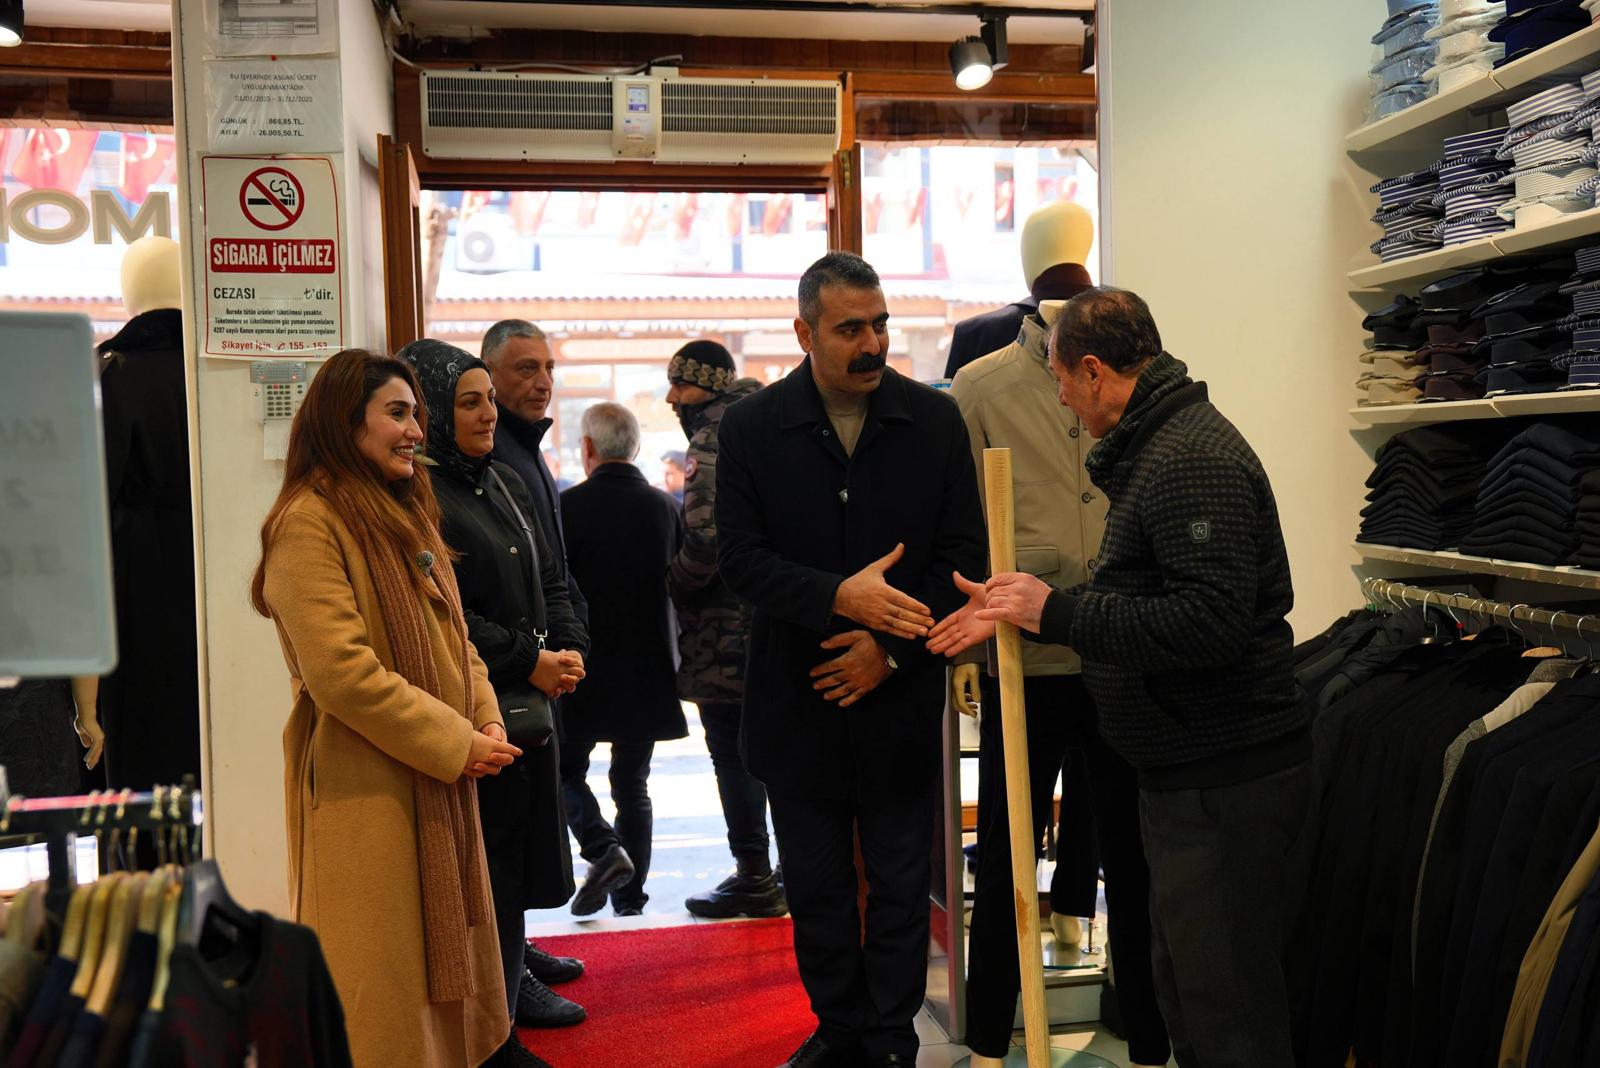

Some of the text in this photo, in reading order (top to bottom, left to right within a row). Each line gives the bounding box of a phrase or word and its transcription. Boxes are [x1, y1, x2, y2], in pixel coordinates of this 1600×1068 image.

[213, 241, 333, 273] SİGARA İÇİLMEZ
[213, 287, 256, 300] CEZASI
[221, 340, 253, 350] Şikayet
[289, 341, 305, 350] 155
